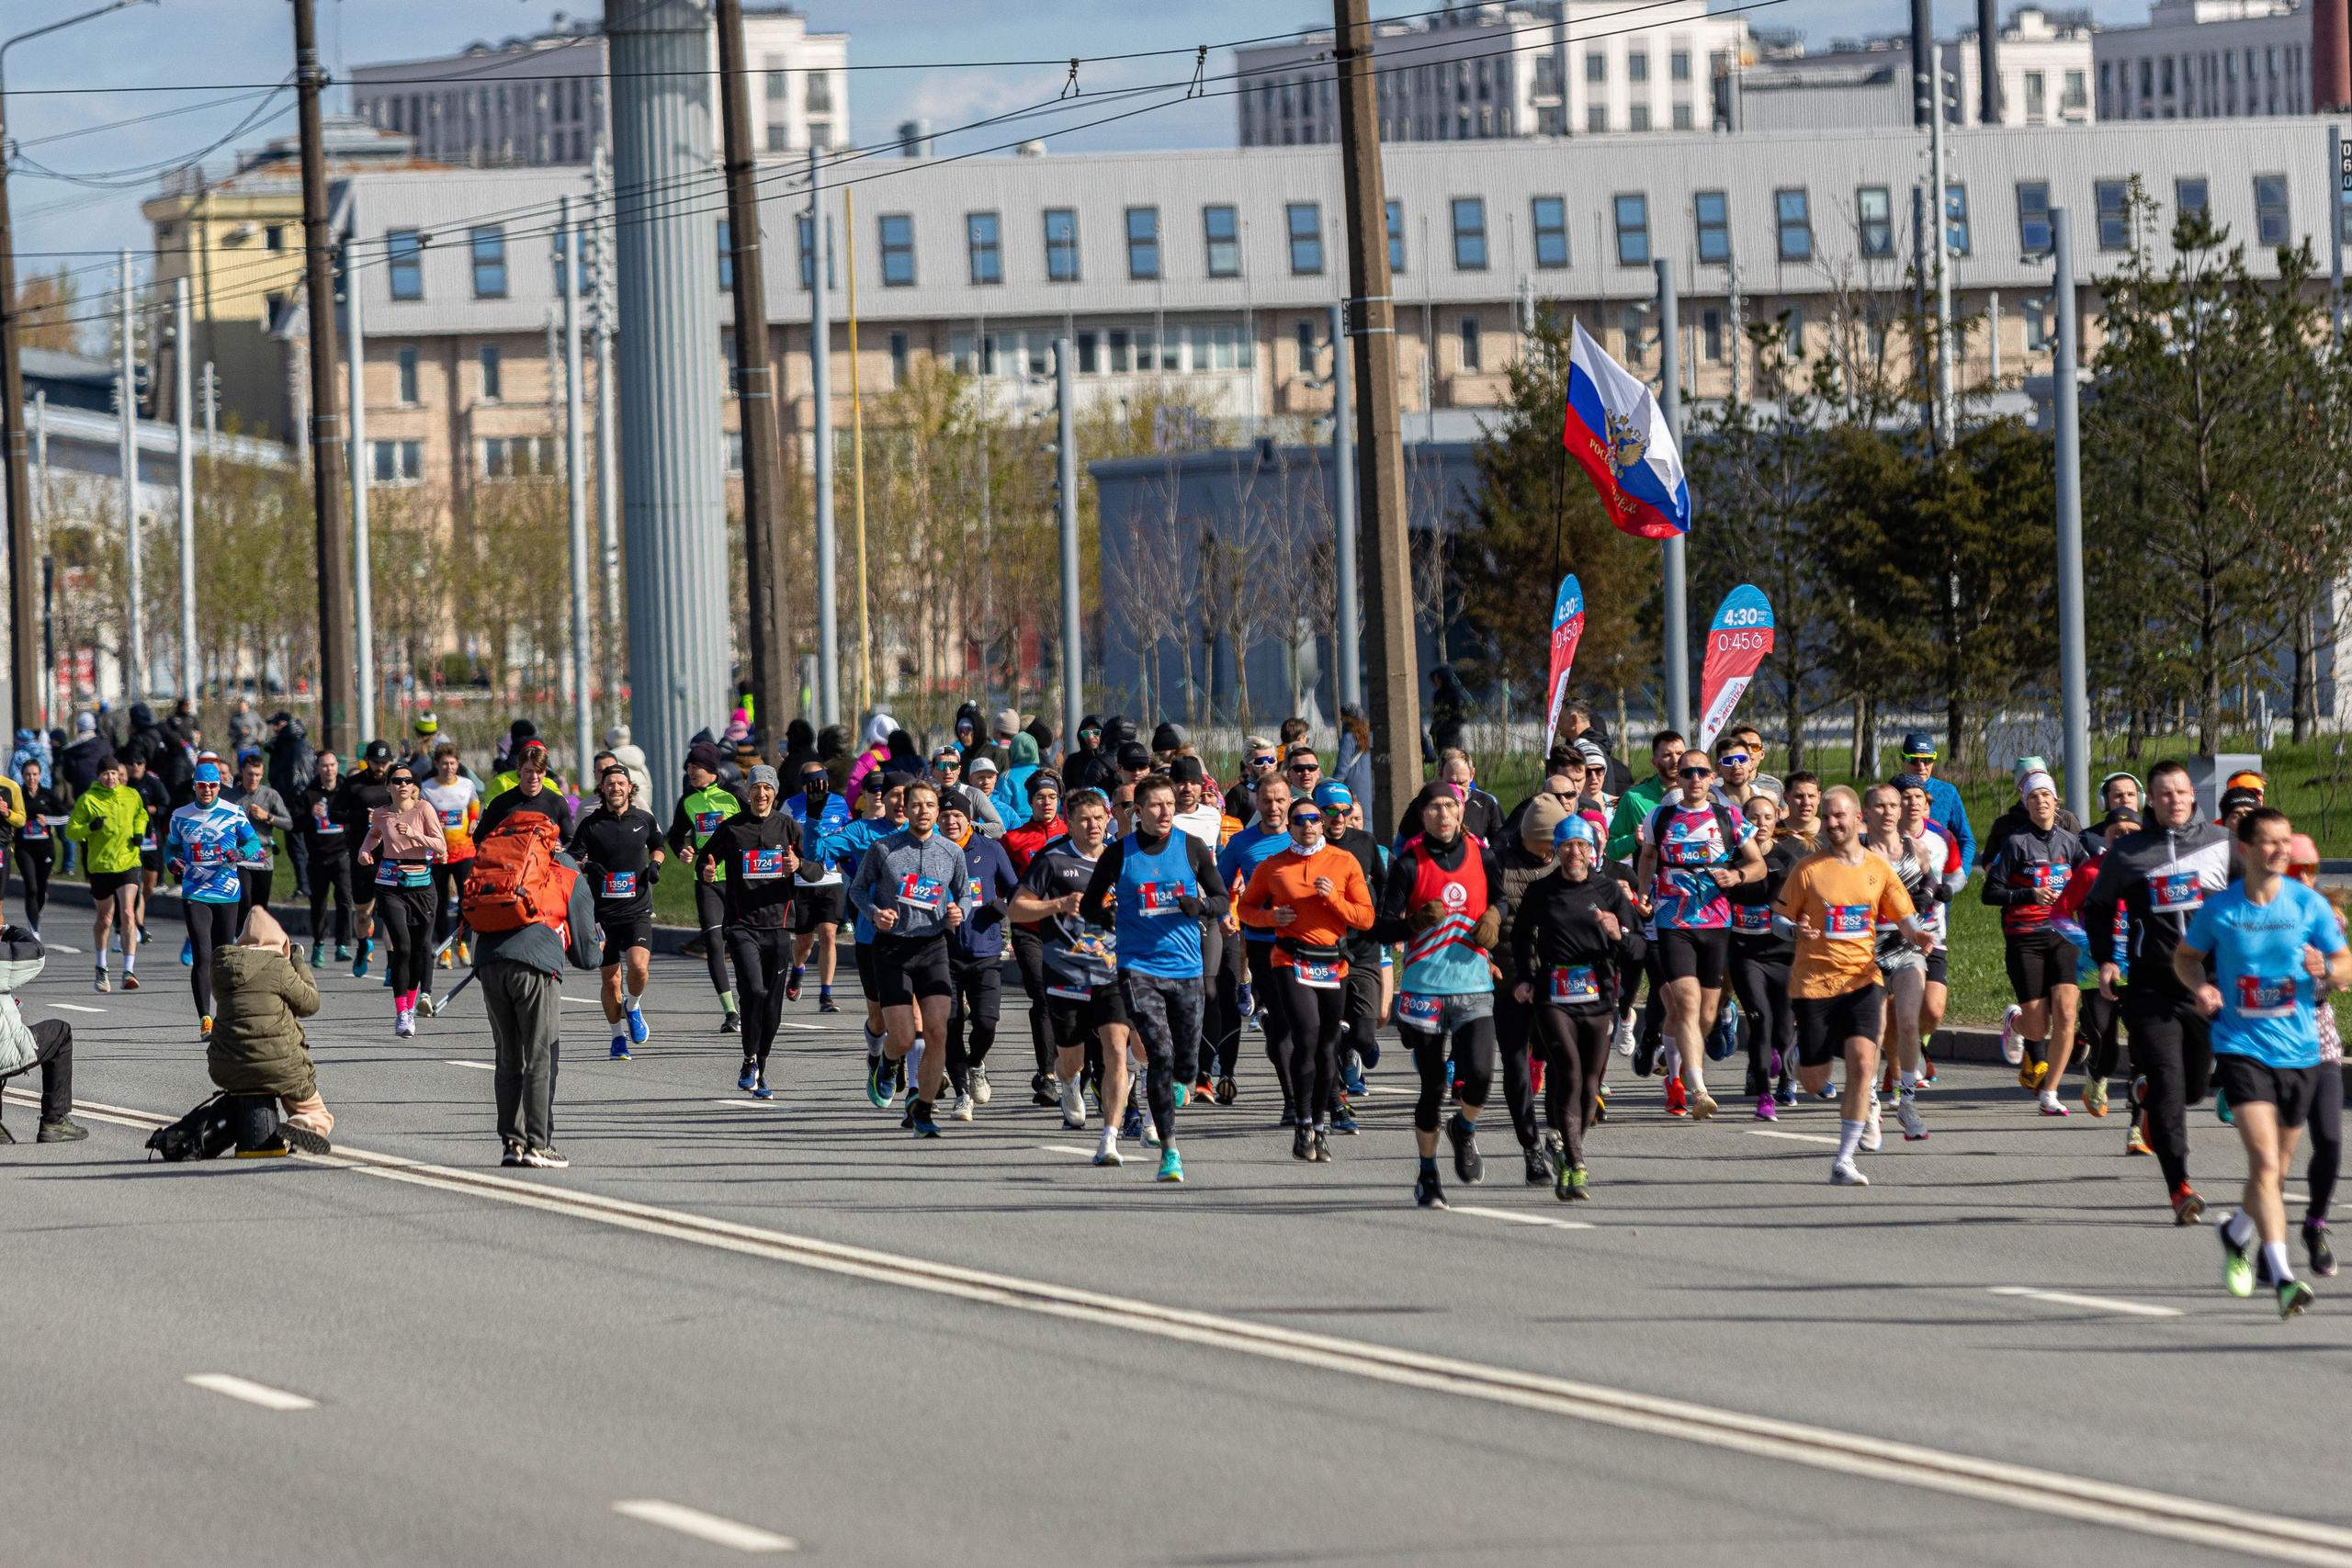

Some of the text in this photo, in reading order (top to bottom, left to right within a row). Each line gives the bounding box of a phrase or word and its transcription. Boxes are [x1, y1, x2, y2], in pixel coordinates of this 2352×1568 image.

[1558, 597, 1576, 622] 4:30
[1724, 608, 1758, 626] 4:30
[1718, 632, 1751, 651] 0:45
[1676, 851, 1700, 862] 1940
[753, 859, 772, 868] 1724
[609, 880, 628, 888] 1350
[2044, 875, 2064, 886] 1386
[910, 883, 931, 897] 1692
[2161, 885, 2188, 897] 1578
[1150, 890, 1173, 903] 1134
[1739, 914, 1759, 923] 1722
[1838, 914, 1861, 926] 1252
[1305, 966, 1329, 976] 1405
[1562, 978, 1587, 989] 1654
[2250, 987, 2280, 1002] 1372
[1404, 997, 1430, 1011] 2007
